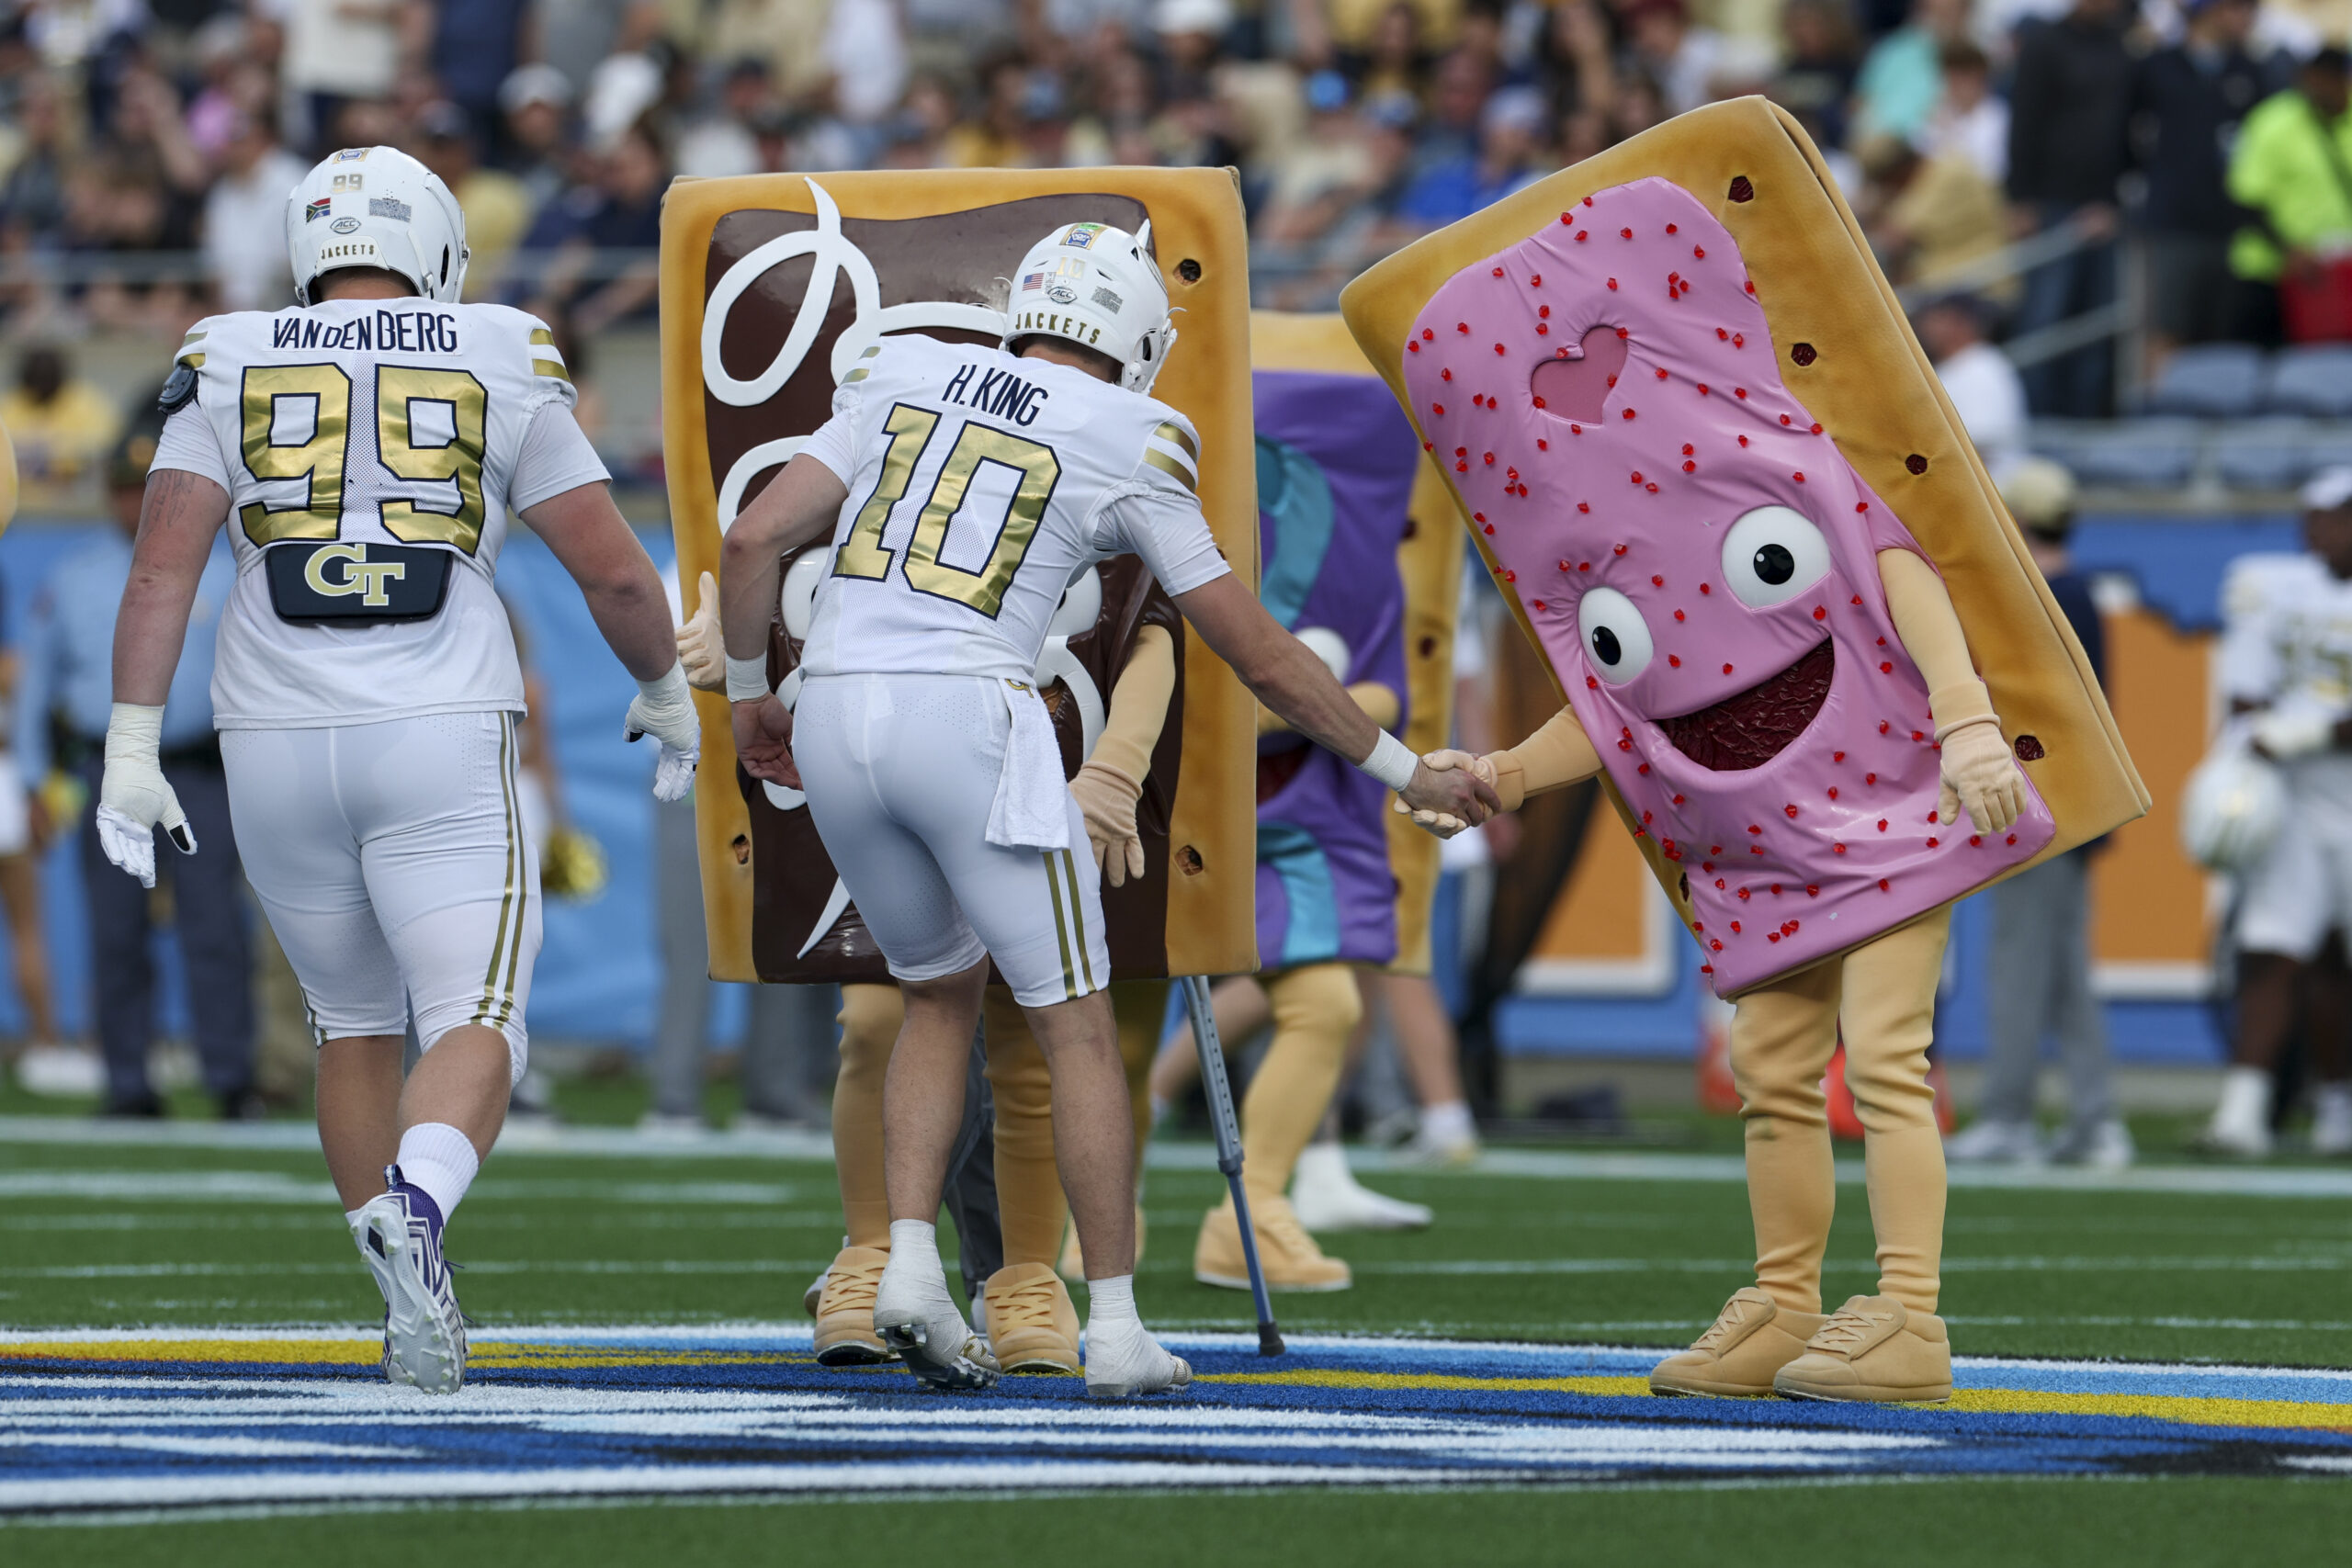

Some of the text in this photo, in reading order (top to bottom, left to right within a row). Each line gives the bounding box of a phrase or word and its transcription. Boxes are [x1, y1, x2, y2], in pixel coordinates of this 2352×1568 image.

[333, 173, 363, 193] 99
[321, 244, 375, 260] JACKETS
[1015, 312, 1101, 344] JACKETS
[238, 362, 489, 558] 99
[830, 401, 1062, 620] 10
[304, 543, 405, 606] GT
